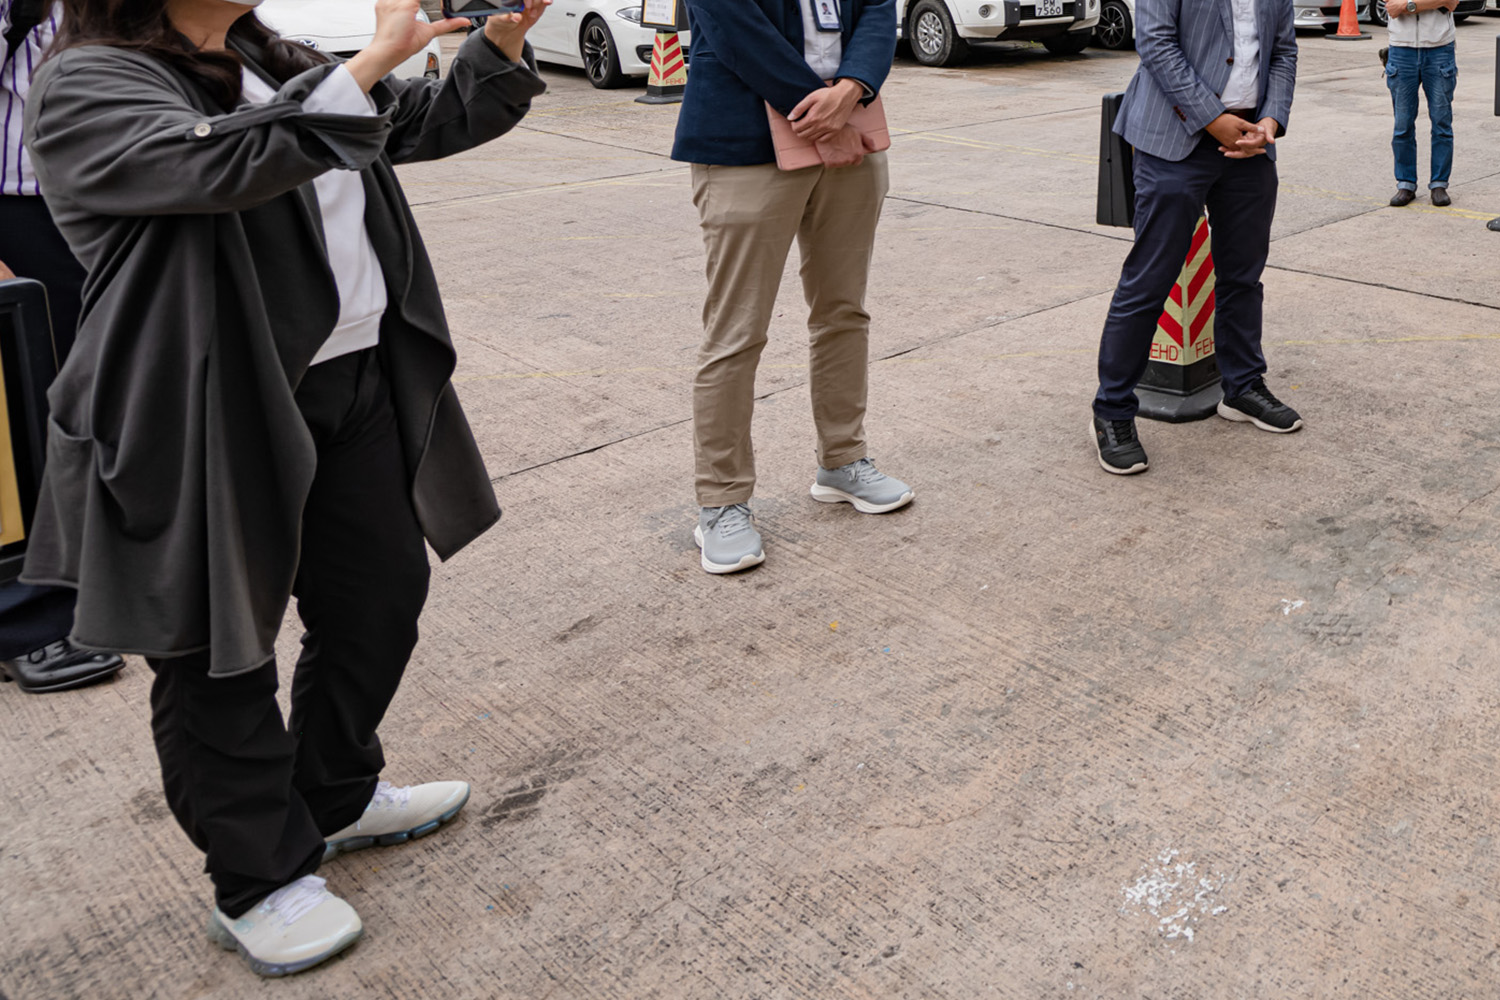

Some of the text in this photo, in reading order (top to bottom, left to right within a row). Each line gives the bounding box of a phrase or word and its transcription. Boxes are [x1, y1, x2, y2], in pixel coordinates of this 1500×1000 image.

[1043, 0, 1056, 7] PM
[1037, 6, 1061, 16] 7560
[1150, 342, 1179, 361] EHD
